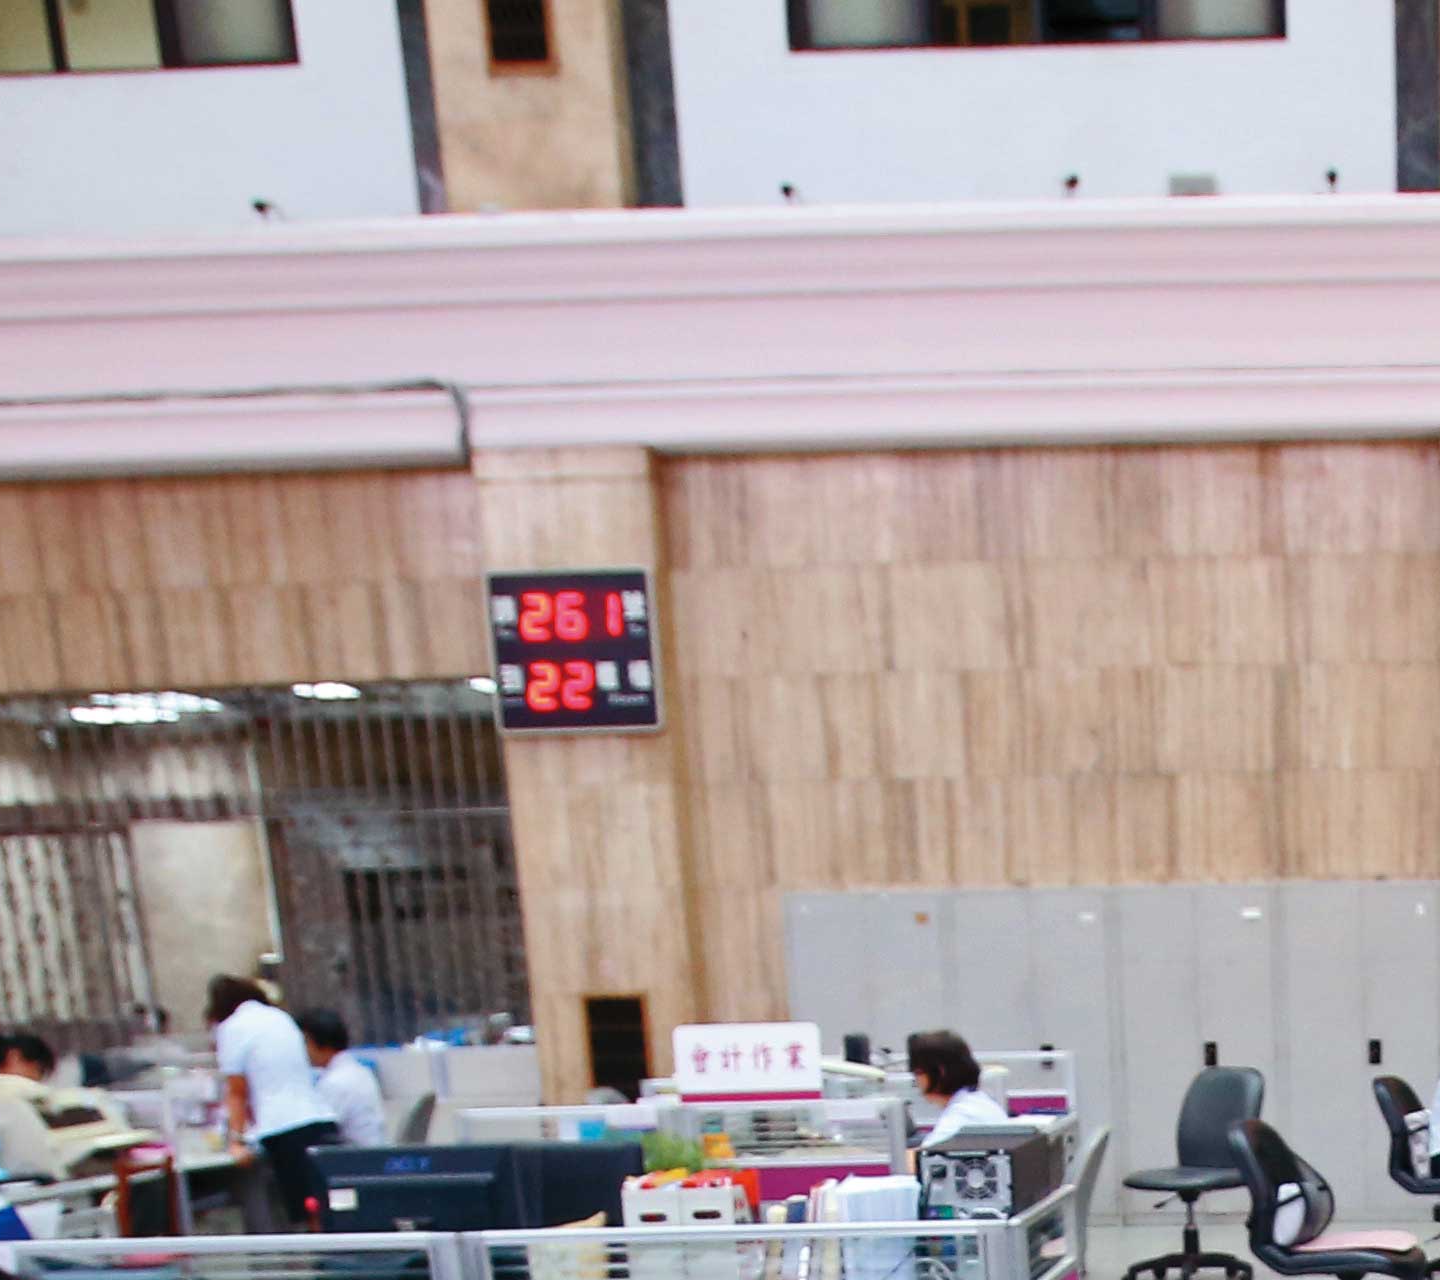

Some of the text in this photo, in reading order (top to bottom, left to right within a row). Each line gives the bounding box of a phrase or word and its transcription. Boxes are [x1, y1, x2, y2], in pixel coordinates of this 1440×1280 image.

[526, 661, 596, 711] 22
[690, 1040, 807, 1075] 會計作業
